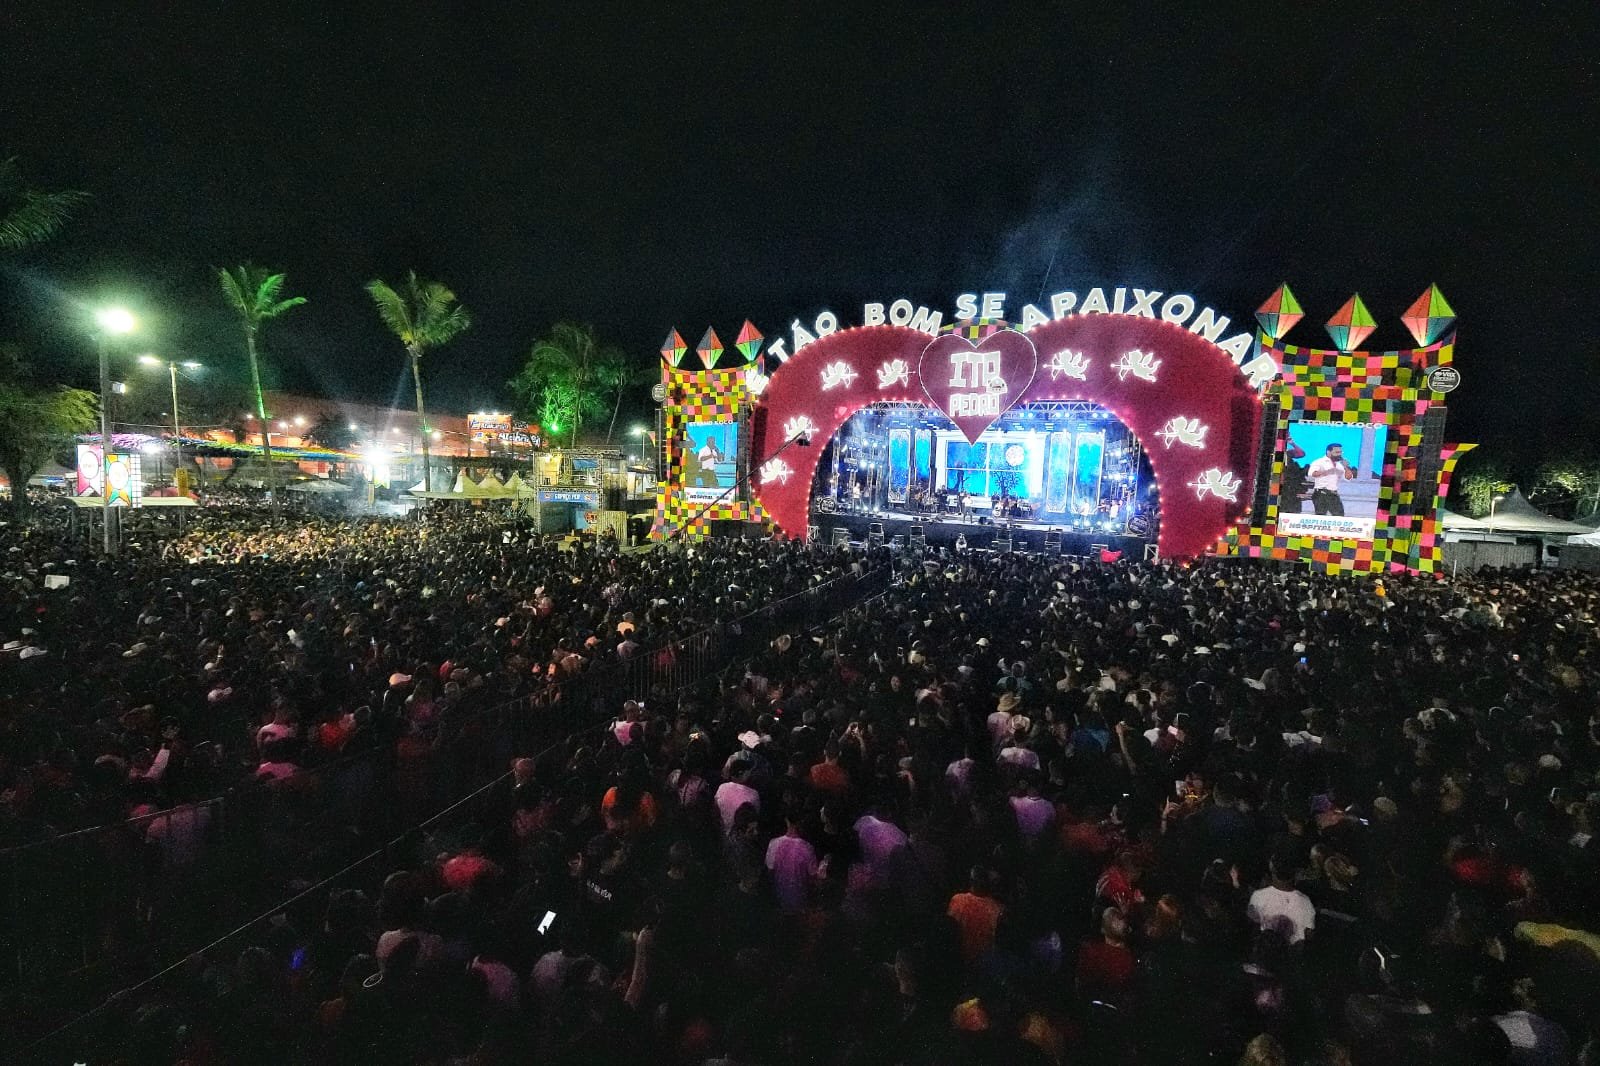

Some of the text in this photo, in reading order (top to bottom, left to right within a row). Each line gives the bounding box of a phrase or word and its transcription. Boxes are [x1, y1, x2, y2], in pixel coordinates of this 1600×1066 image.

[767, 311, 837, 363] TÃO
[864, 299, 943, 337] BOM
[955, 293, 1006, 320] SE
[1022, 287, 1278, 388] APAIXONAR
[949, 393, 1000, 417] PEDRO
